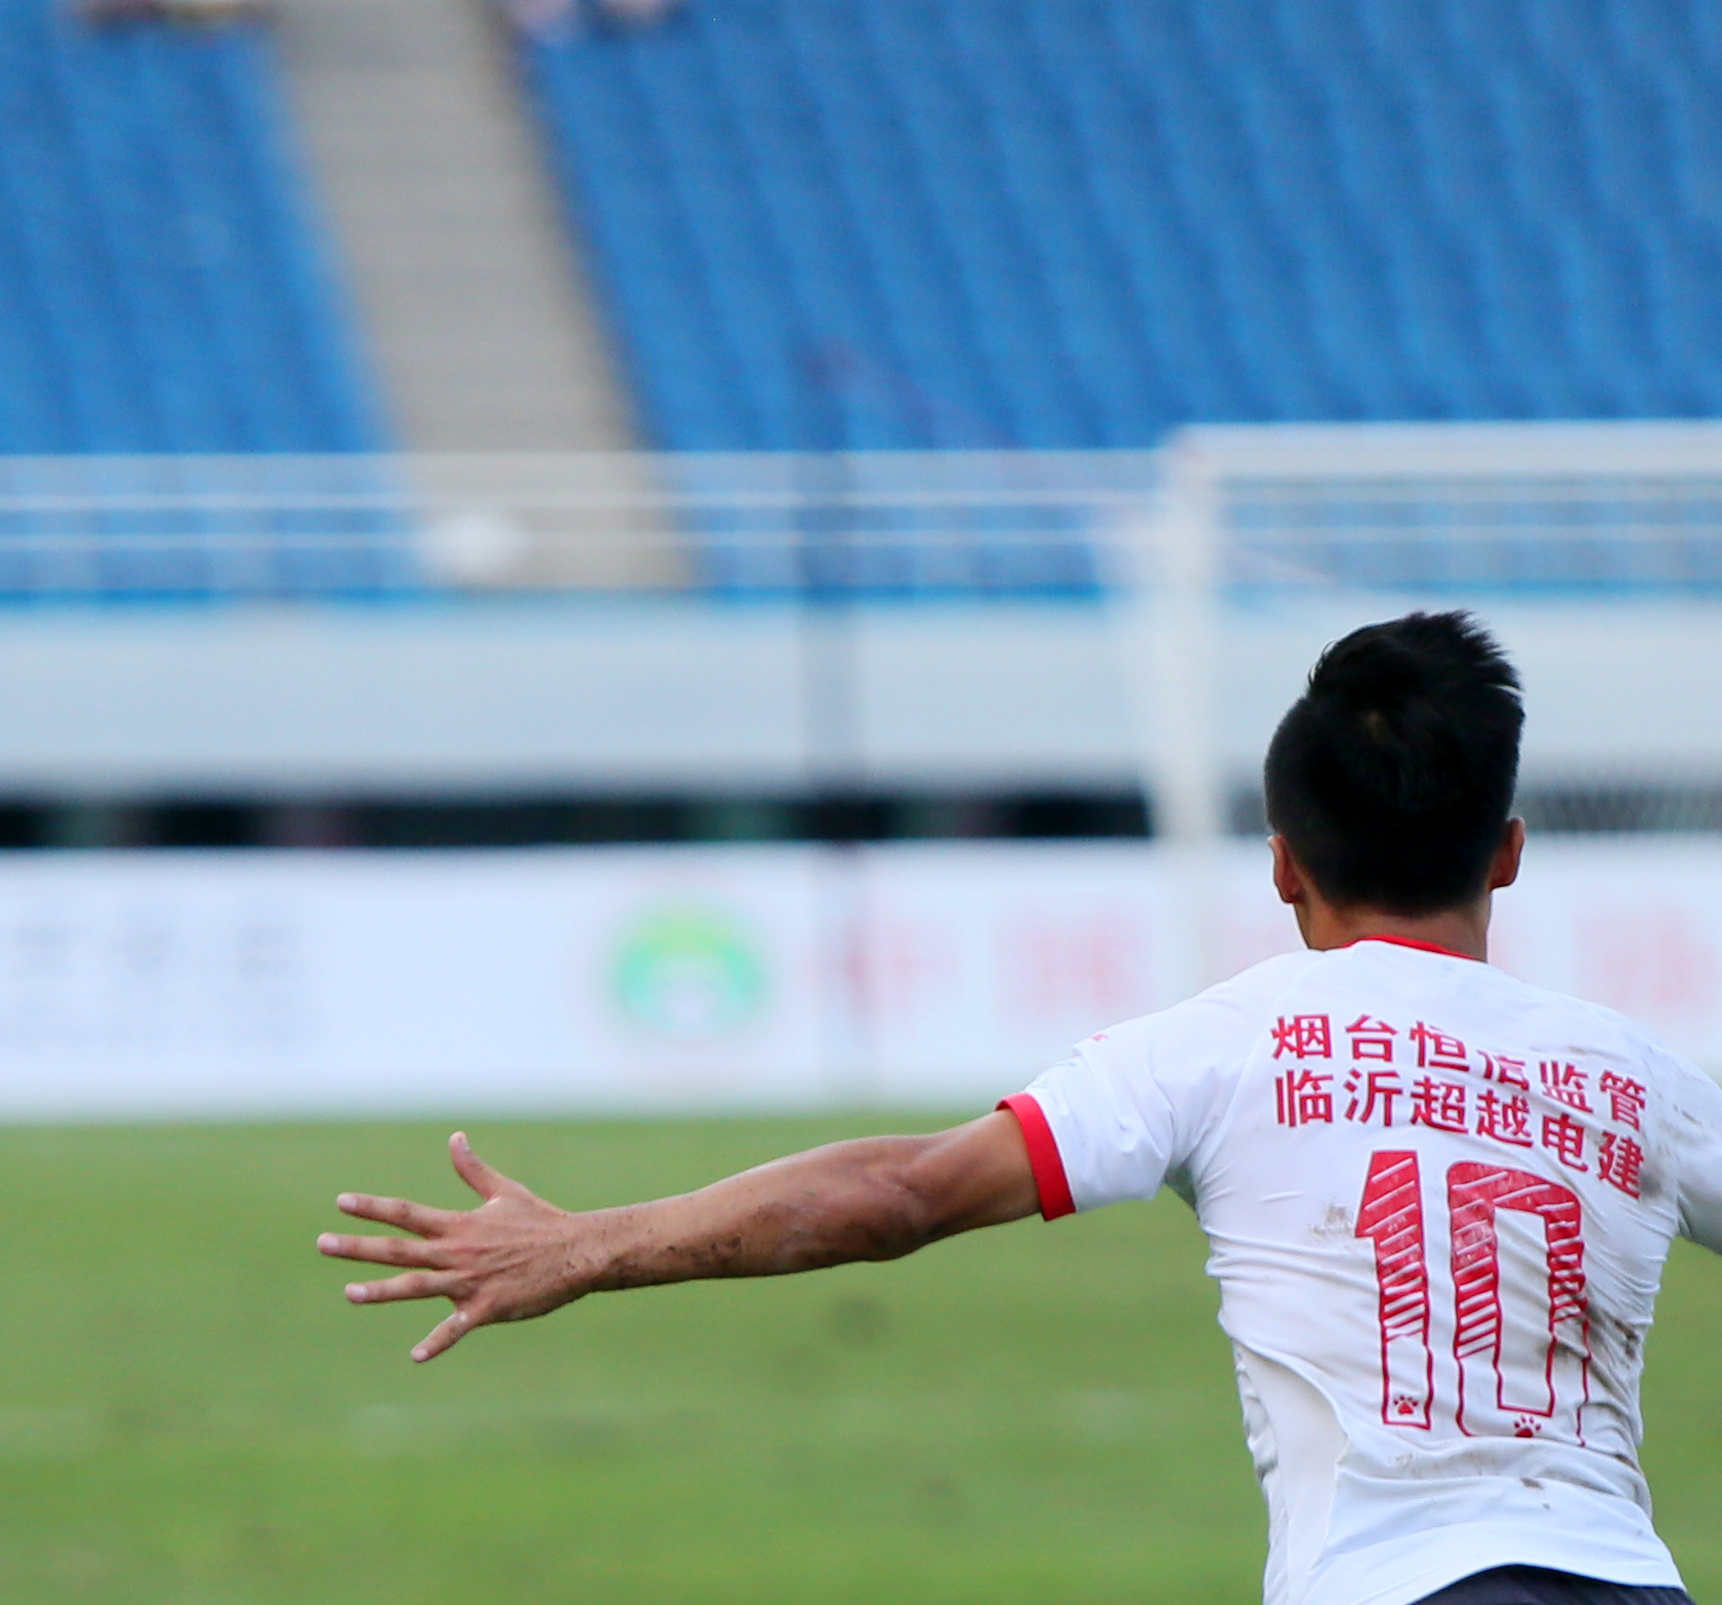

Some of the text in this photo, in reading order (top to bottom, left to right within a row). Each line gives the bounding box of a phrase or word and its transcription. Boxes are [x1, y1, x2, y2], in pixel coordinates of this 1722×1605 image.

[1271, 1013, 1647, 1132] 烟台恒信监管
[1275, 1068, 1646, 1200] 临沂超越电建
[1355, 1149, 1590, 1446] 10
